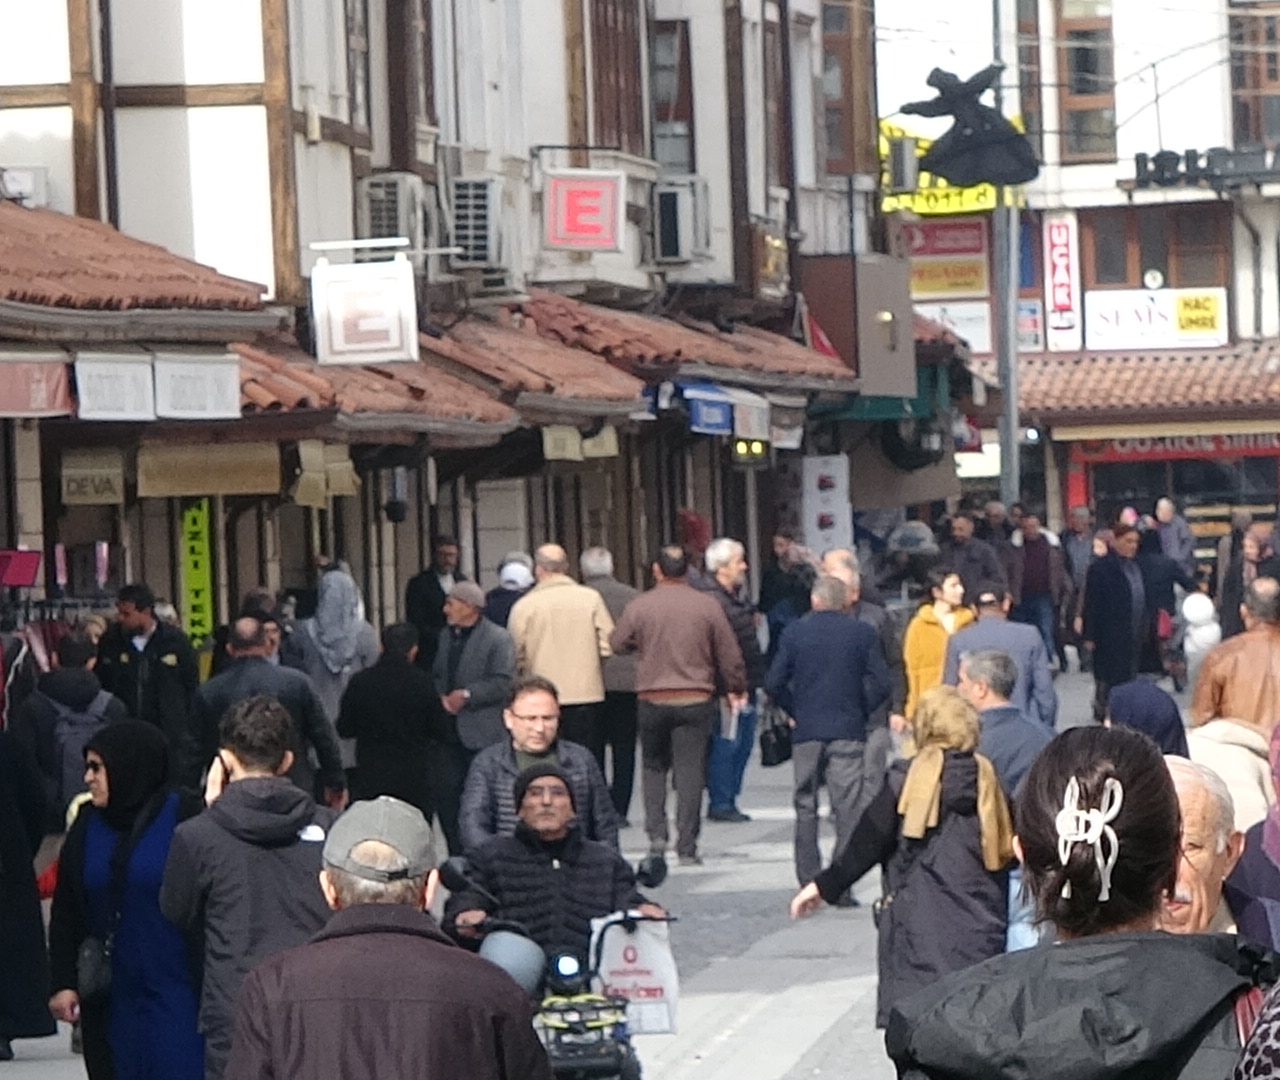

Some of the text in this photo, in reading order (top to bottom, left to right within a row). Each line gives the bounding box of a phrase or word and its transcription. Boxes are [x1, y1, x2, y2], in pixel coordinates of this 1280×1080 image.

[565, 189, 603, 234] E
[342, 290, 390, 345] E
[66, 477, 117, 496] DEVA
